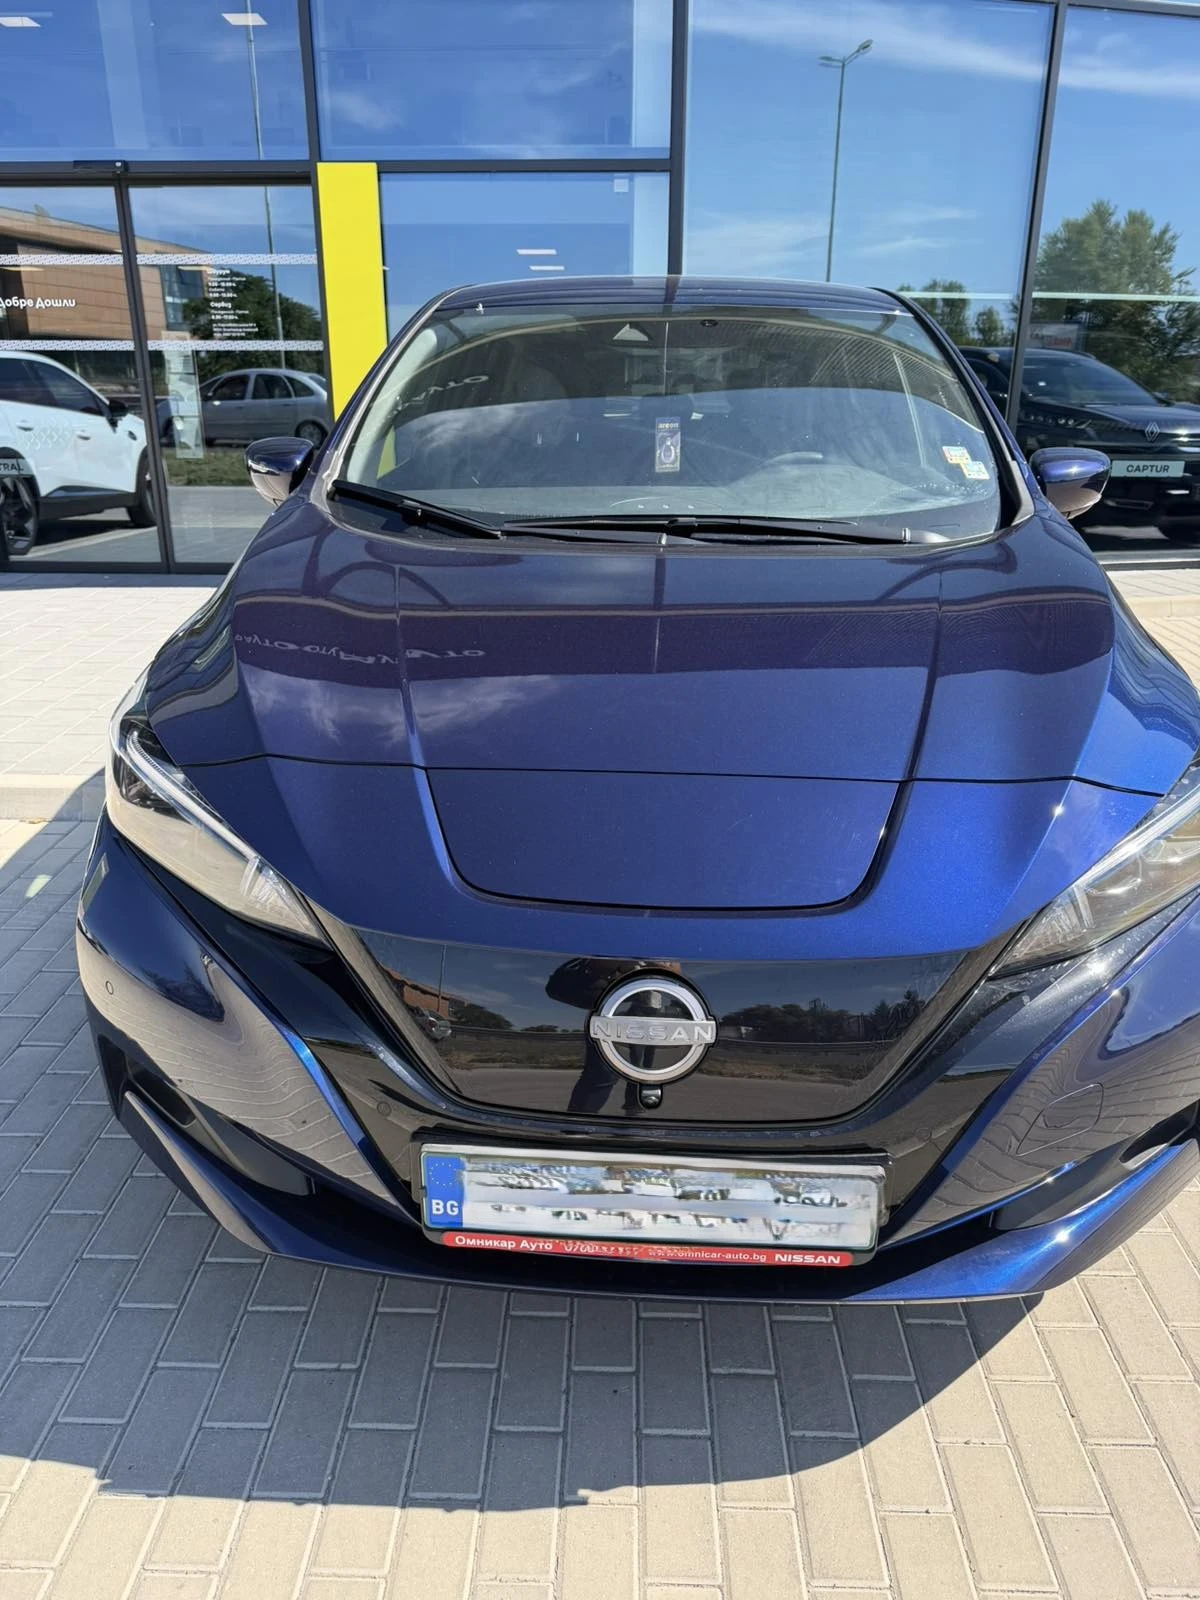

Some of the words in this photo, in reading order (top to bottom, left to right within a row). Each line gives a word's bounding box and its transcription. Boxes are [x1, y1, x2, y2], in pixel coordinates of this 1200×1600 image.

[35, 296, 76, 309] Дошли
[1126, 464, 1170, 473] CAPTUR
[592, 1020, 713, 1042] NISSAN
[431, 1199, 460, 1216] BG
[455, 1235, 517, 1250] Омникар
[519, 1239, 553, 1252] Ауто
[774, 1252, 841, 1264] NISSAN
